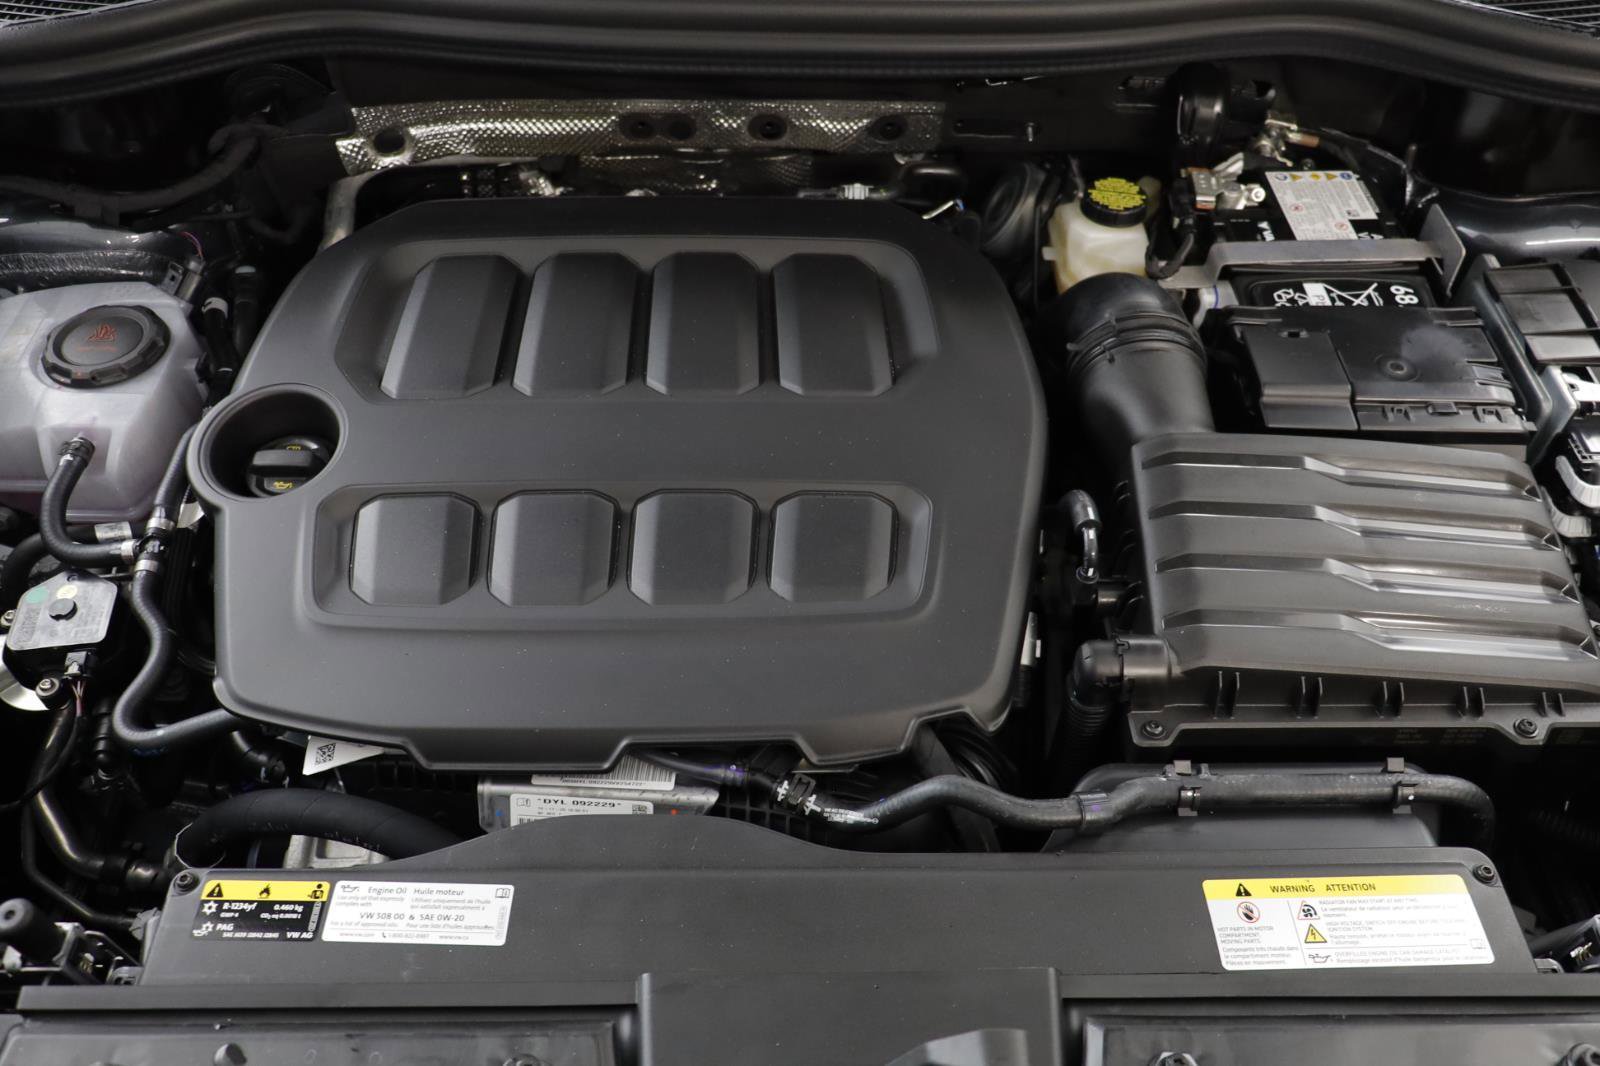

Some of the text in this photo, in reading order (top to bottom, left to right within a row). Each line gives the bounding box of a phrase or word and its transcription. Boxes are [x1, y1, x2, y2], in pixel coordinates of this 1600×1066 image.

[368, 886, 407, 896] Engine Oil
[413, 887, 465, 896] Huile moteur
[1270, 883, 1376, 893] WARNING ATTENTION
[393, 912, 405, 920] 00
[437, 914, 465, 922] 0W-20
[216, 923, 234, 931] PAG
[286, 931, 314, 939] VW AG
